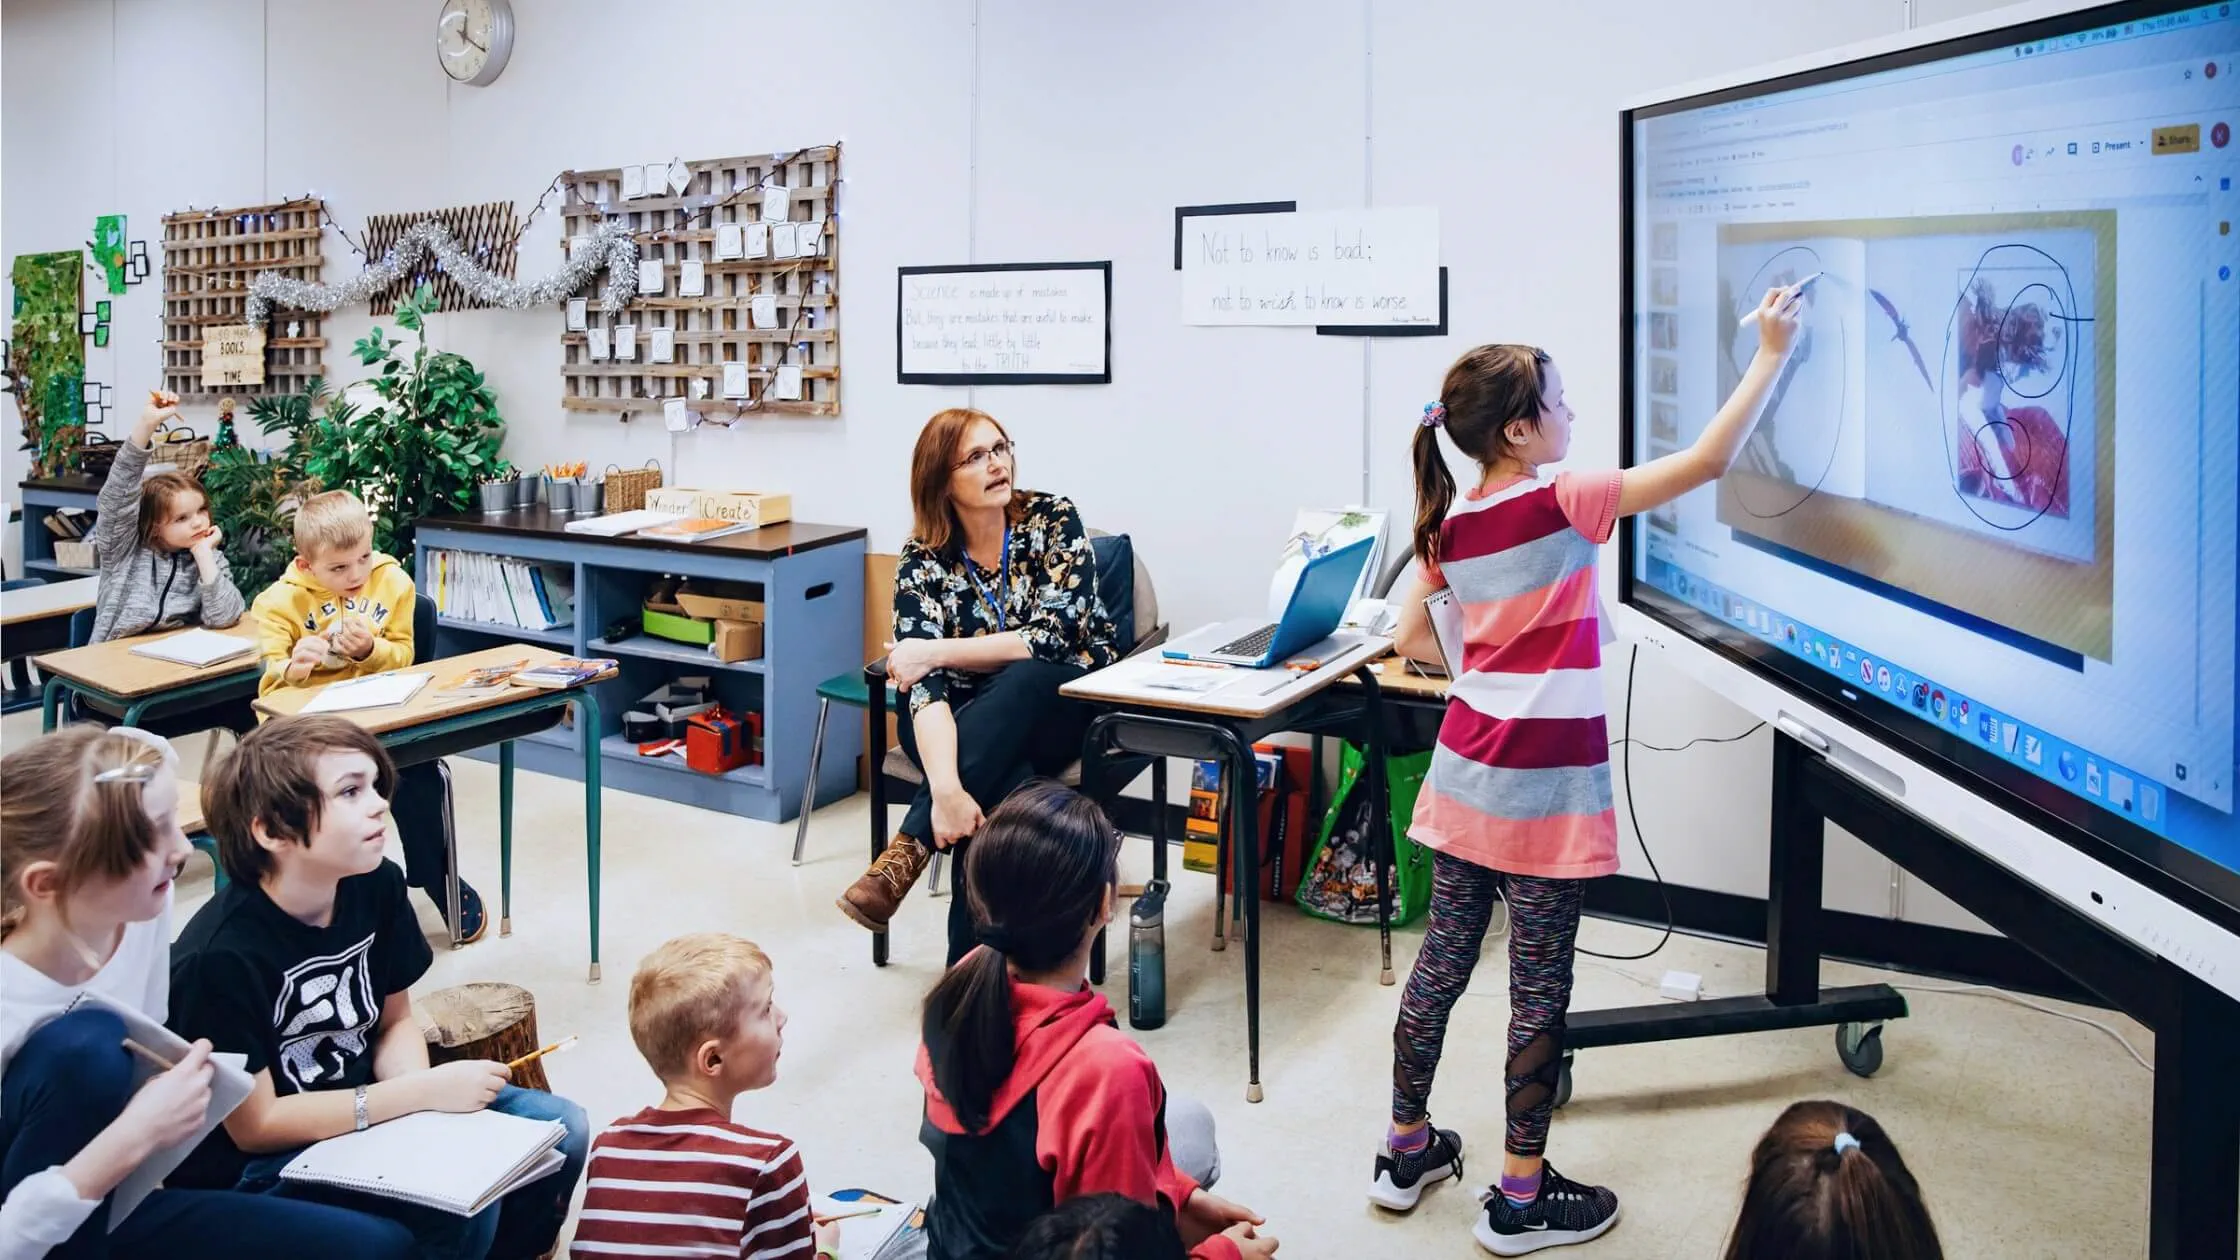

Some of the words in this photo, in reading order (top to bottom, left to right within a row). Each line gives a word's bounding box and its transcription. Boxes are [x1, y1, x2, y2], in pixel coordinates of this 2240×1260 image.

[2104, 140, 2131, 151] Present
[1202, 231, 1229, 265] Not
[1240, 231, 1253, 264] to
[1266, 229, 1298, 263] know
[1308, 243, 1319, 261] is
[1212, 285, 1232, 311] not
[1240, 285, 1252, 311] to
[1260, 290, 1297, 311] wish
[1305, 285, 1316, 310] to
[1321, 280, 1348, 310] know
[1355, 294, 1365, 310] is
[1372, 295, 1409, 310] worse
[949, 314, 963, 324] are
[965, 309, 999, 323] mistakes
[1002, 311, 1018, 324] that
[1022, 314, 1033, 323] are
[994, 353, 1029, 369] TRUTH
[224, 371, 241, 384] TIME
[649, 496, 688, 514] Wonder
[704, 497, 751, 521] Create
